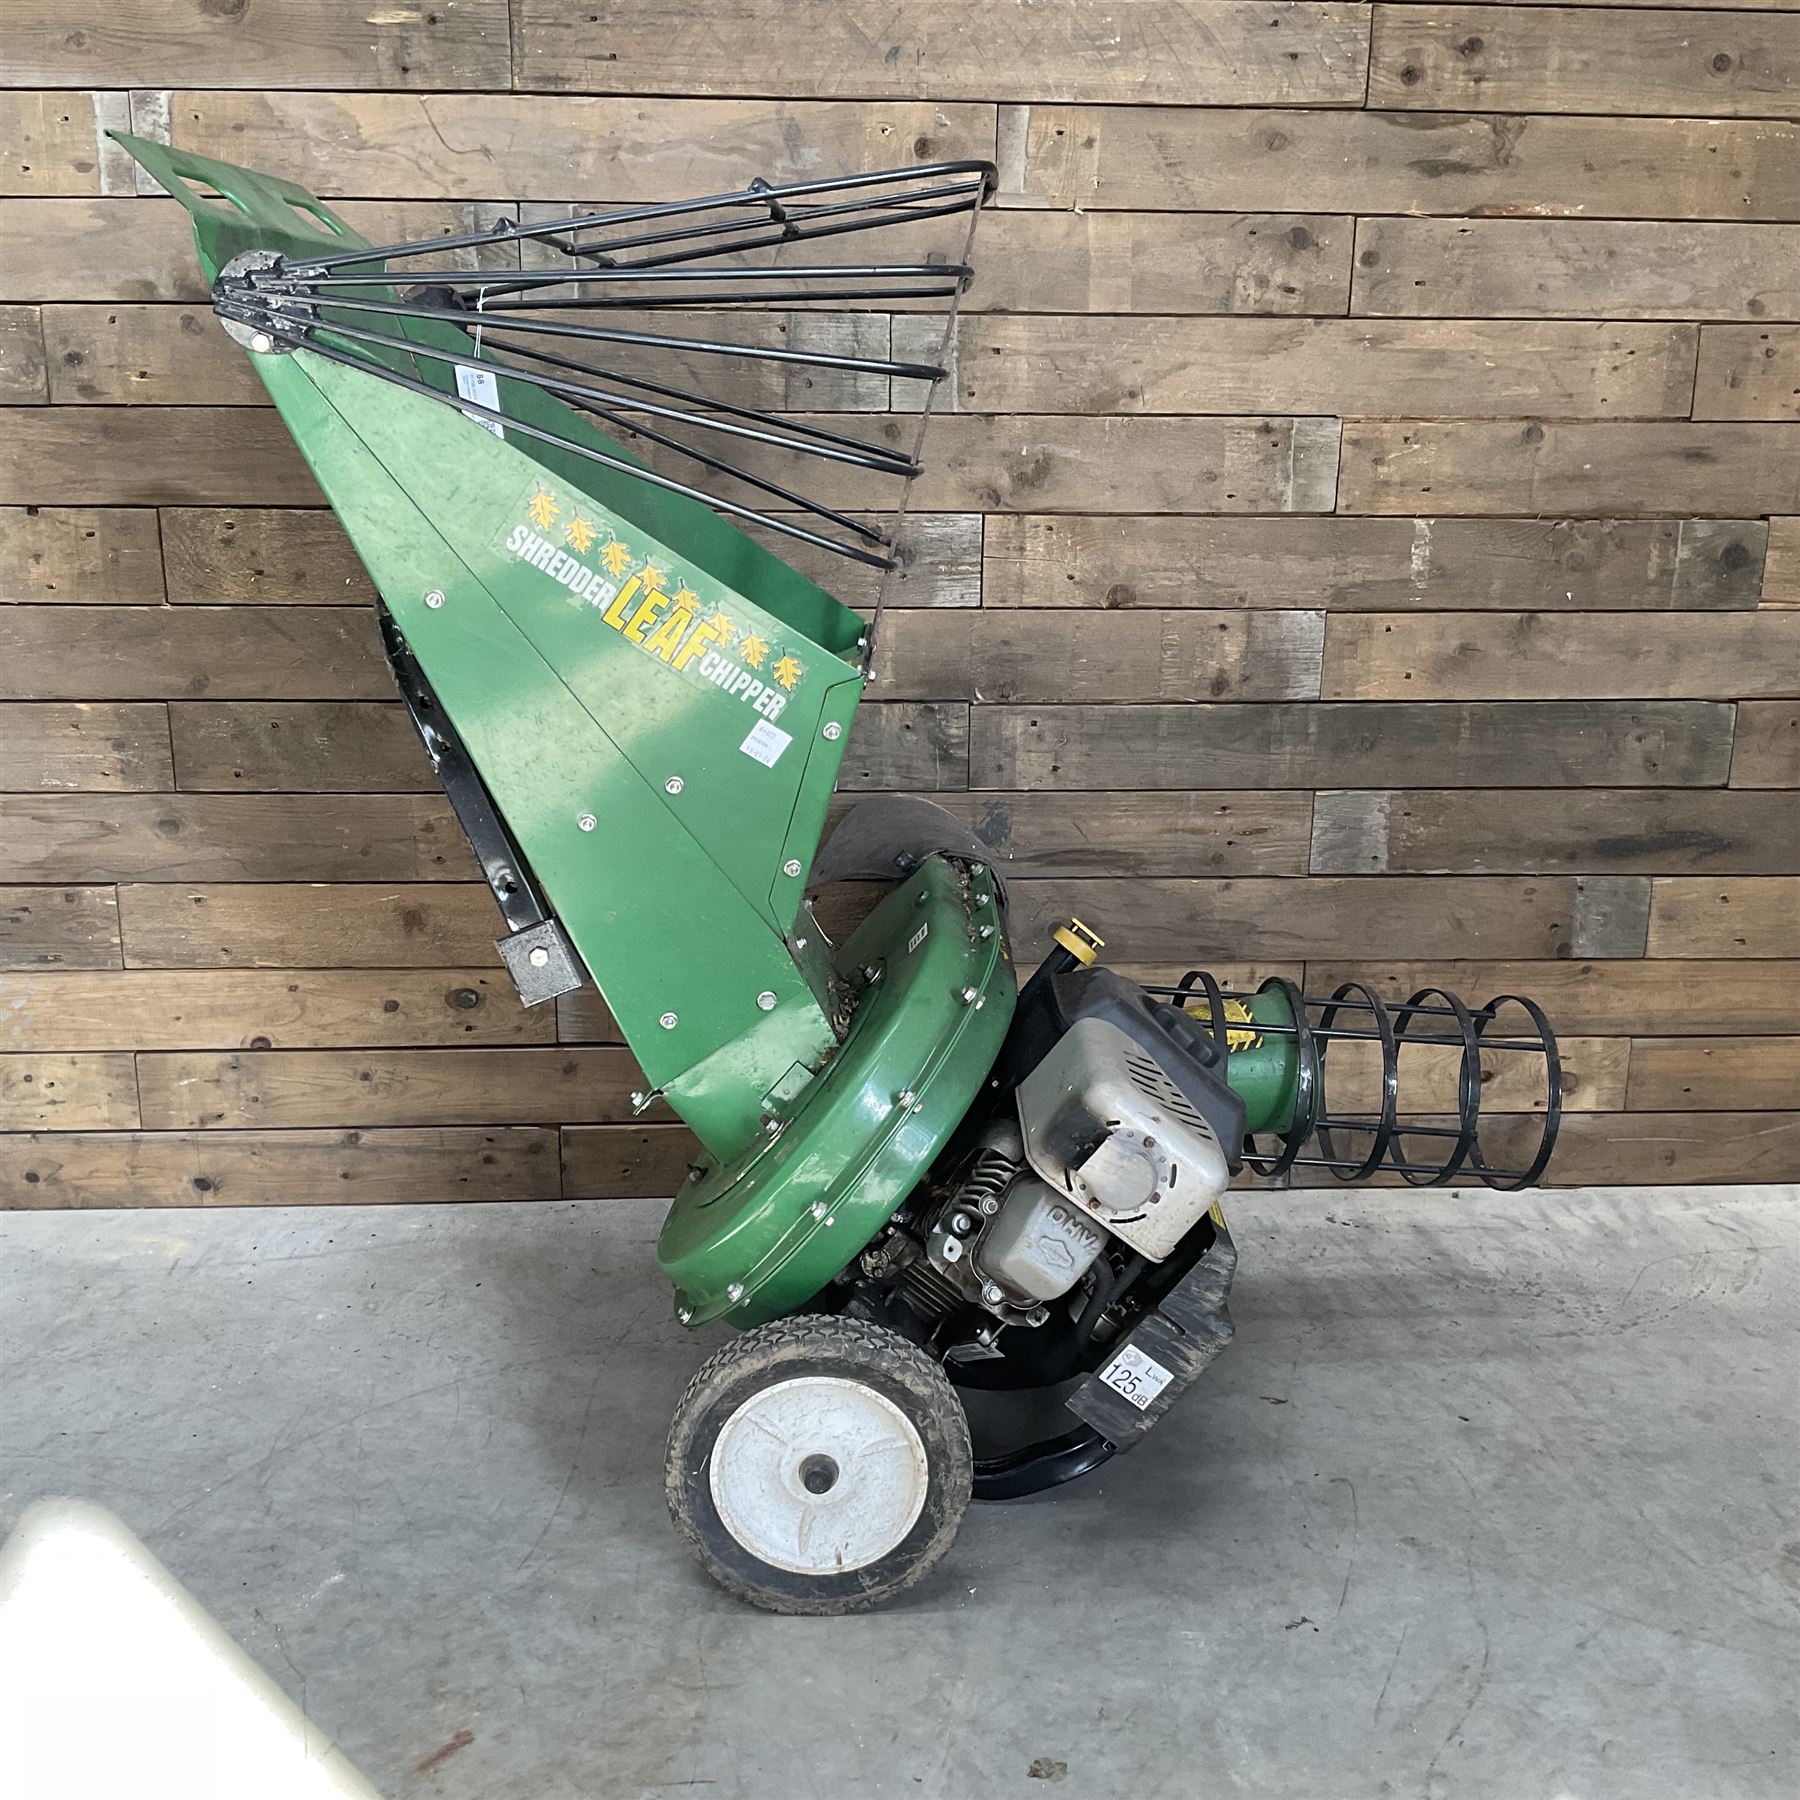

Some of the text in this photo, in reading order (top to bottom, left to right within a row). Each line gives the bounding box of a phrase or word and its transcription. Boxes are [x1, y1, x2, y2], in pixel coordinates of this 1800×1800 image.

[506, 525, 787, 721] SHREDDER LEAF CHIPPER
[1047, 1205, 1098, 1248] OHV
[1106, 1363, 1148, 1407] 125 dB
